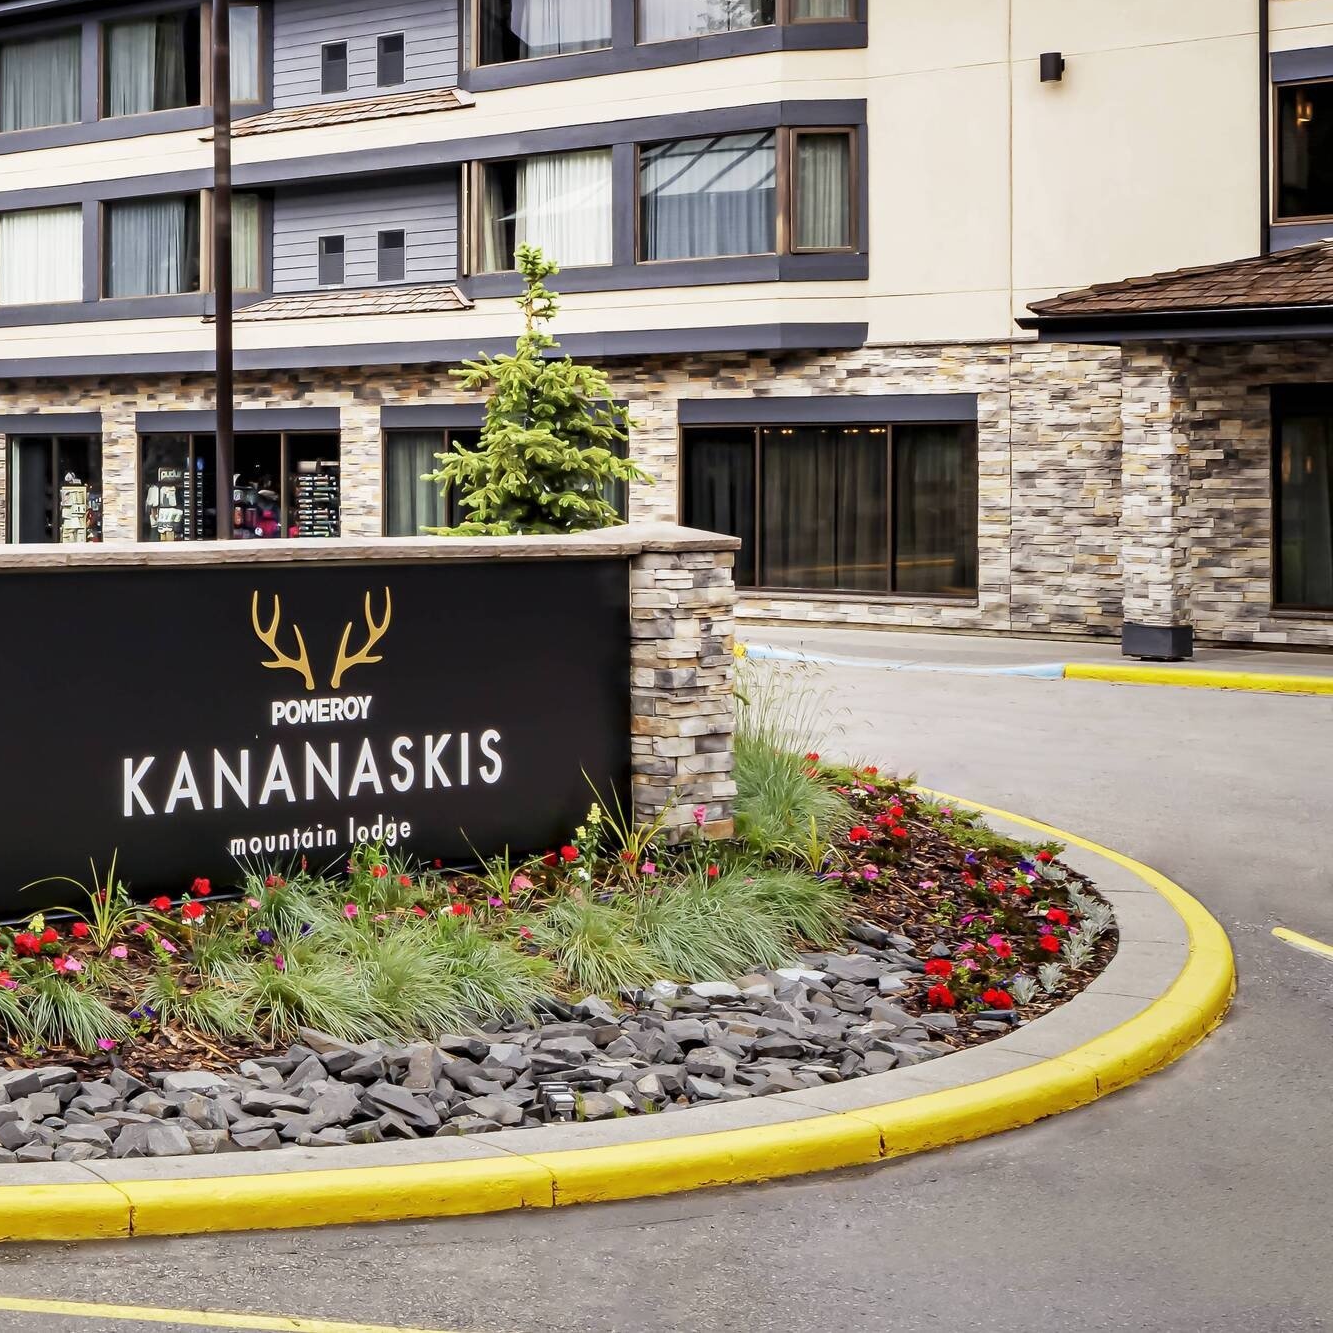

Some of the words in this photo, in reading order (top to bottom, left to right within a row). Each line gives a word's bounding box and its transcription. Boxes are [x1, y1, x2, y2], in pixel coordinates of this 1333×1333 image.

[271, 695, 373, 726] POMEROY
[122, 728, 503, 817] KANANASKIS
[229, 823, 337, 856] mountain
[348, 813, 412, 847] lodge
